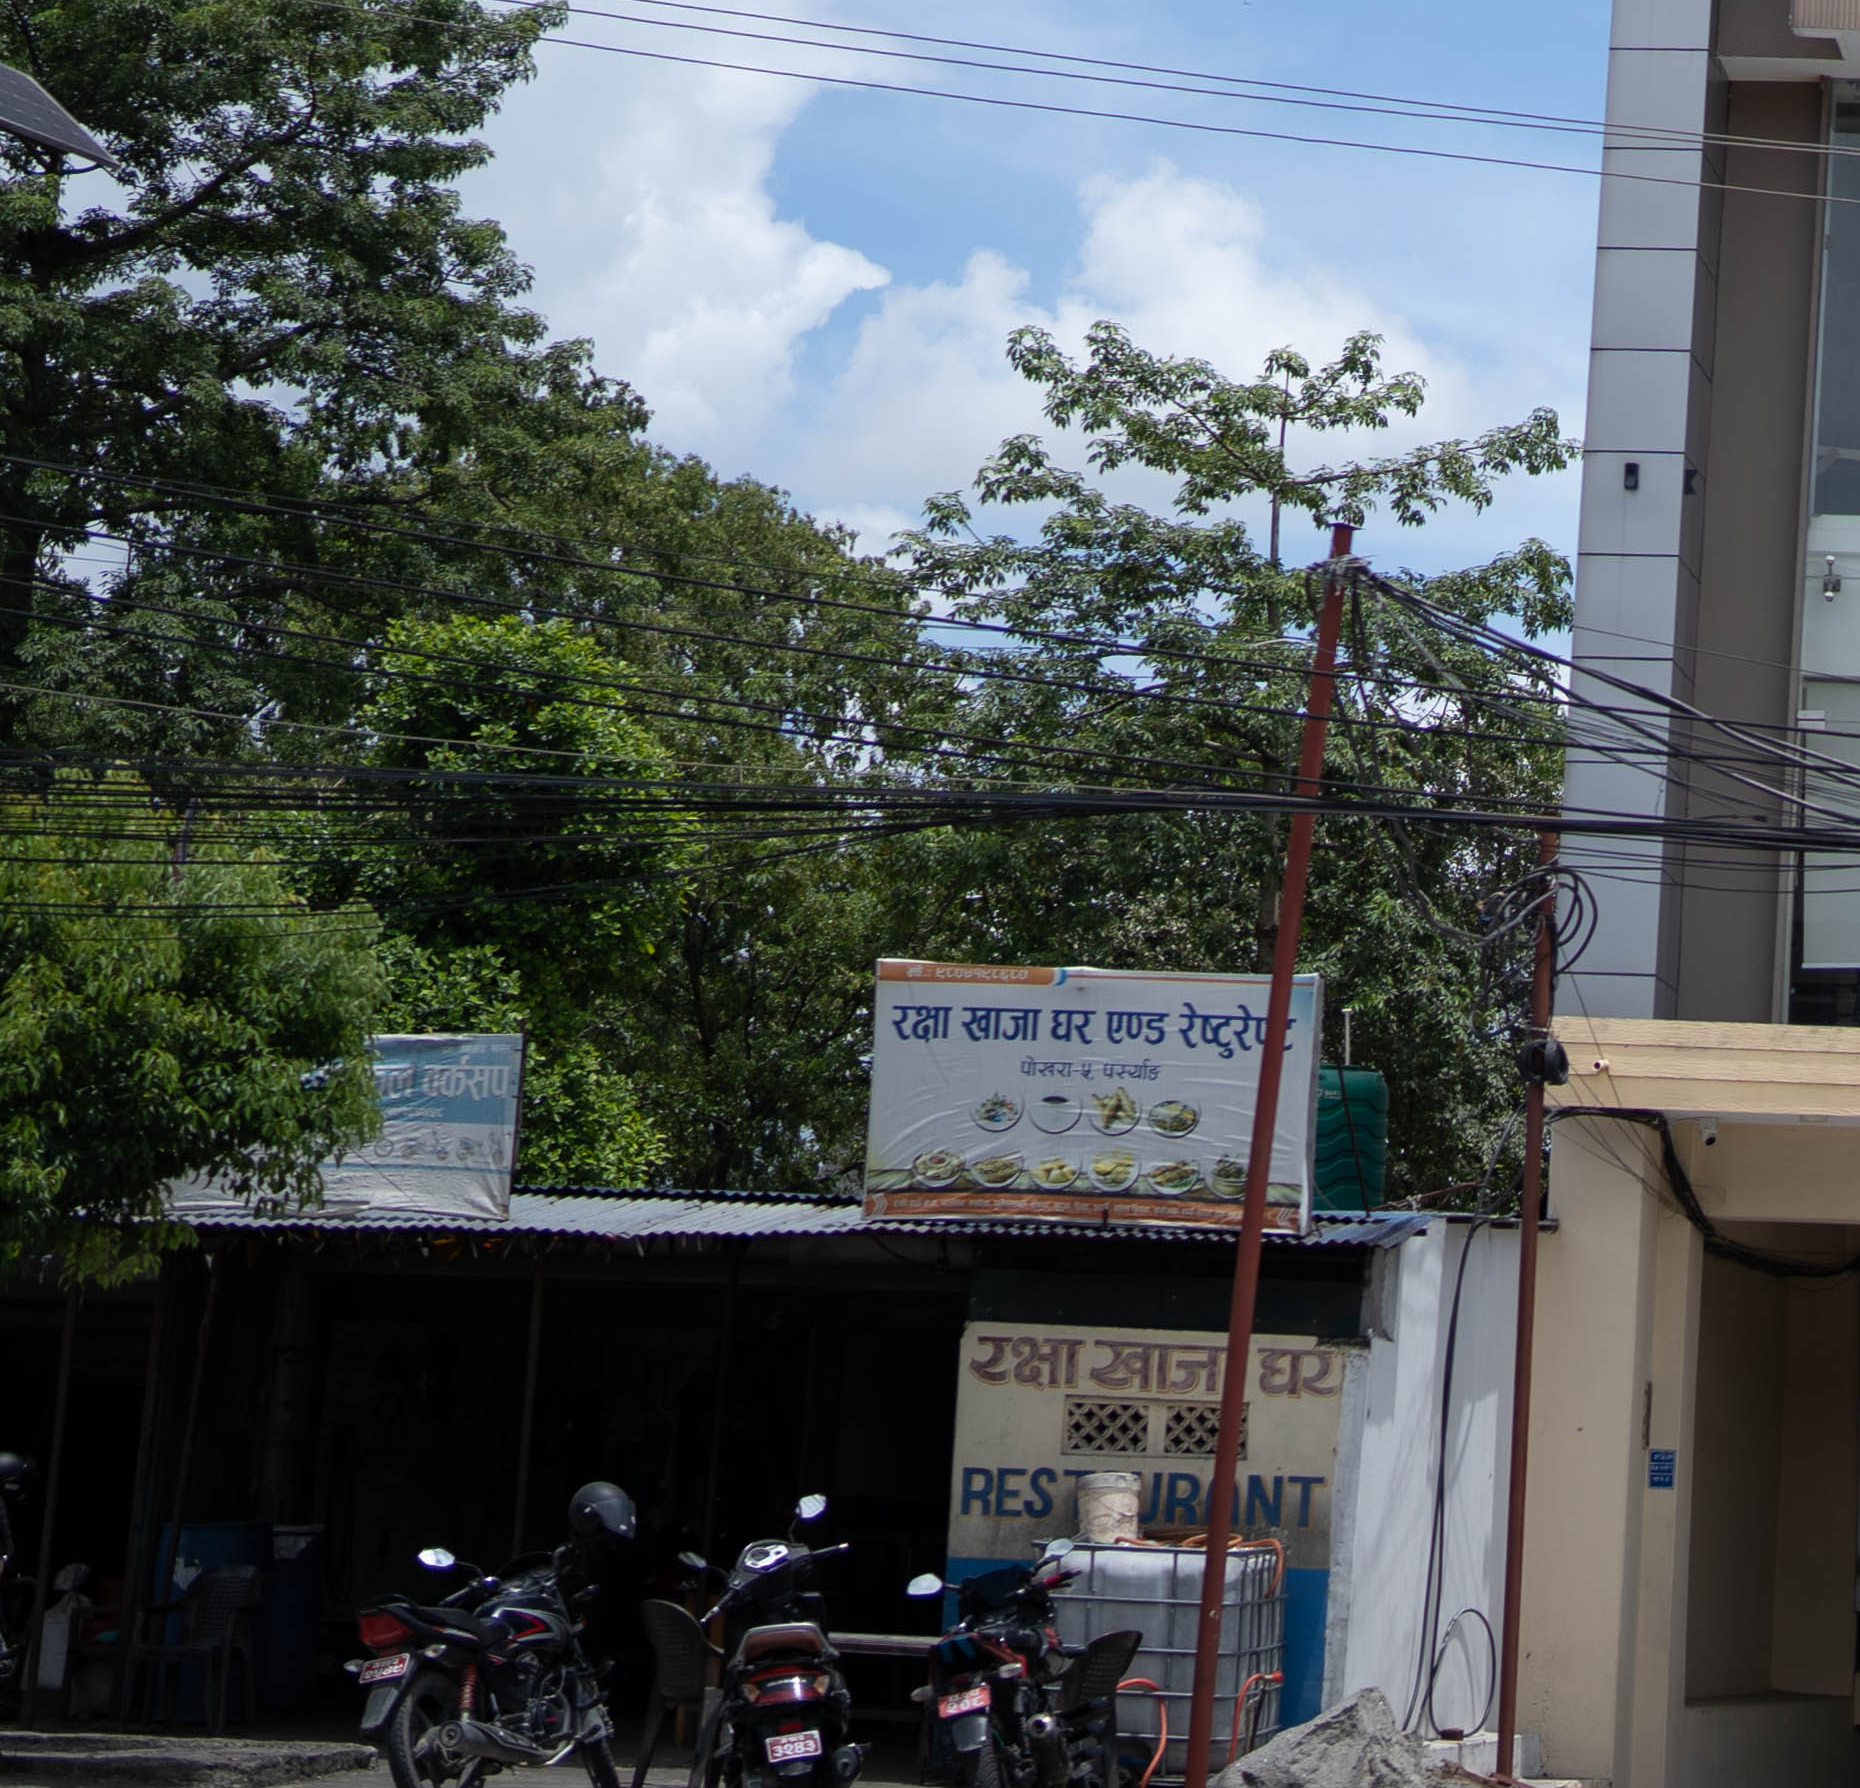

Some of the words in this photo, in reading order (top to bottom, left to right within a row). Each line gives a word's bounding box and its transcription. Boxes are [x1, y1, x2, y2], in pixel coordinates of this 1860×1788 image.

[891, 1005, 952, 1043] रक्षा
[961, 1007, 1042, 1042] खाजा
[1050, 1009, 1096, 1045] घर
[1106, 1011, 1170, 1045] एण्ड
[969, 1336, 1085, 1390] रक्षा
[1089, 1339, 1228, 1393] खाज
[1257, 1347, 1338, 1397] घर
